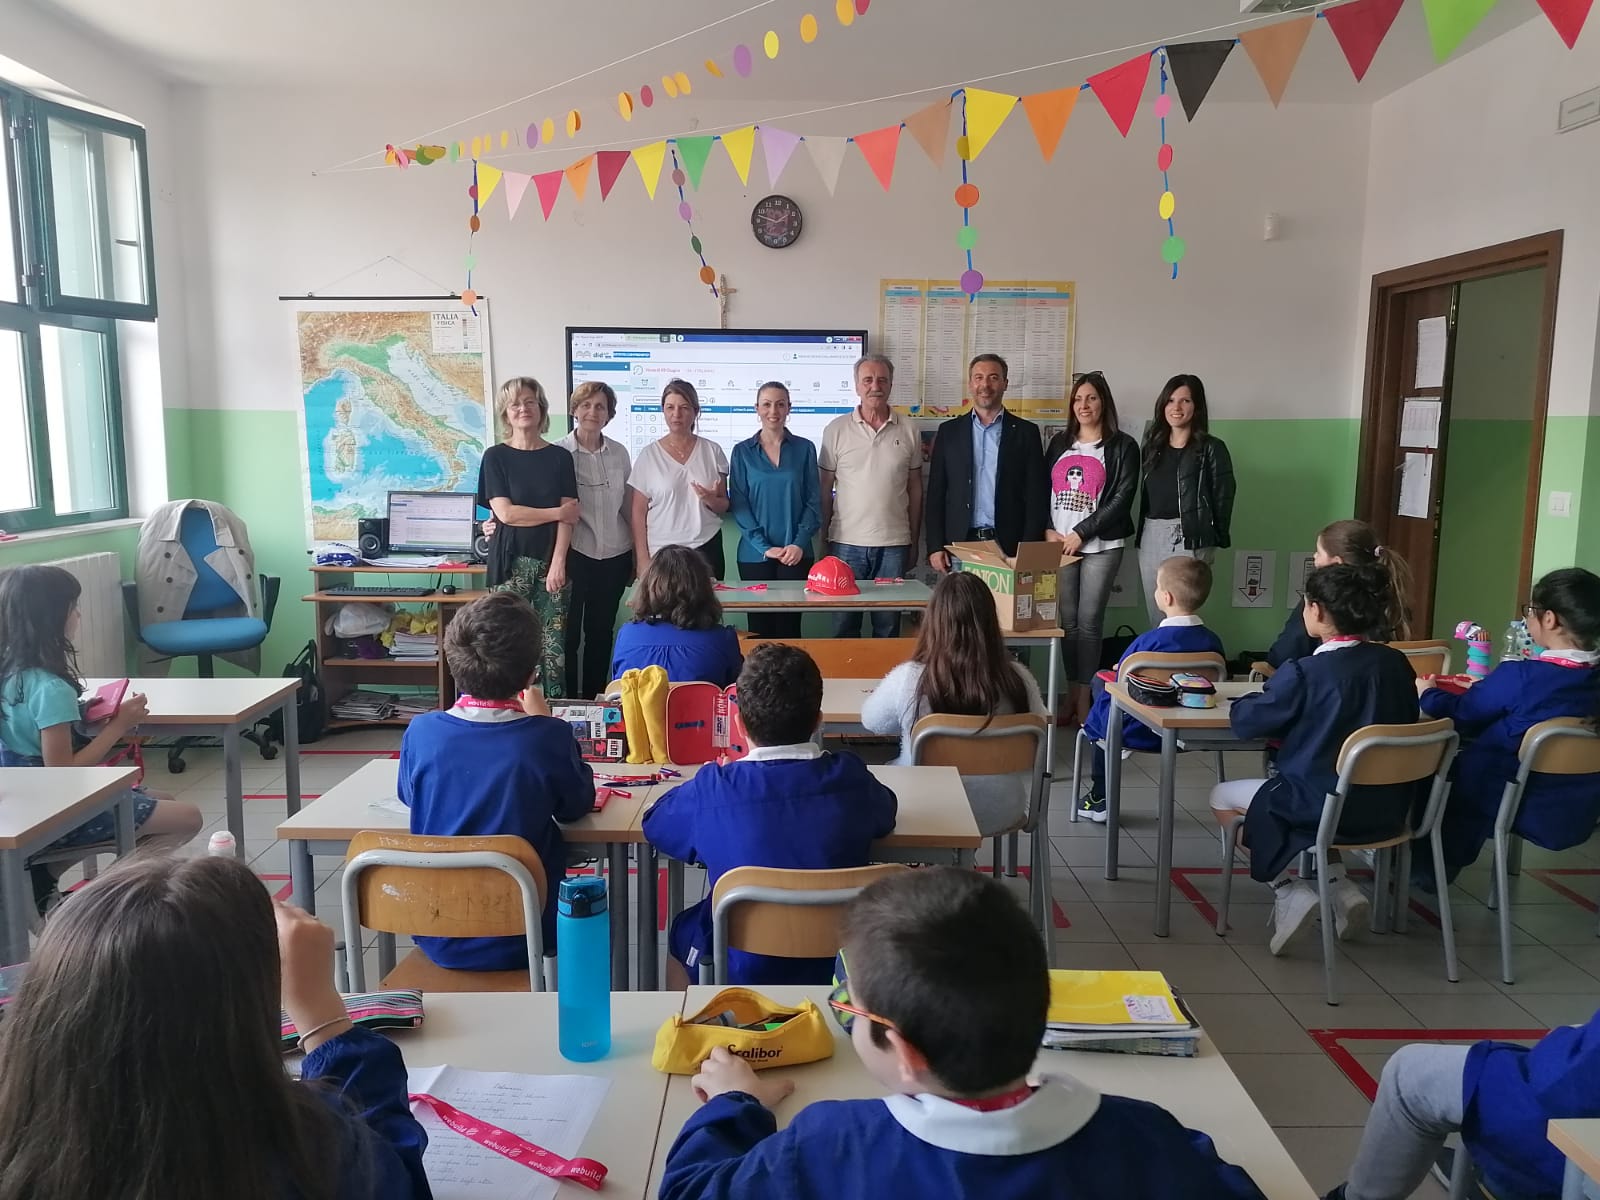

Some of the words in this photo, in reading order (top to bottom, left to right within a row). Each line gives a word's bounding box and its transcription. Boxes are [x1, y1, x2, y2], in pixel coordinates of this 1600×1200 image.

[728, 1044, 782, 1058] Scalibor
[442, 1115, 467, 1134] webuild
[483, 1139, 509, 1154] webuild
[528, 1160, 554, 1175] webuild
[570, 1166, 602, 1182] webuild
